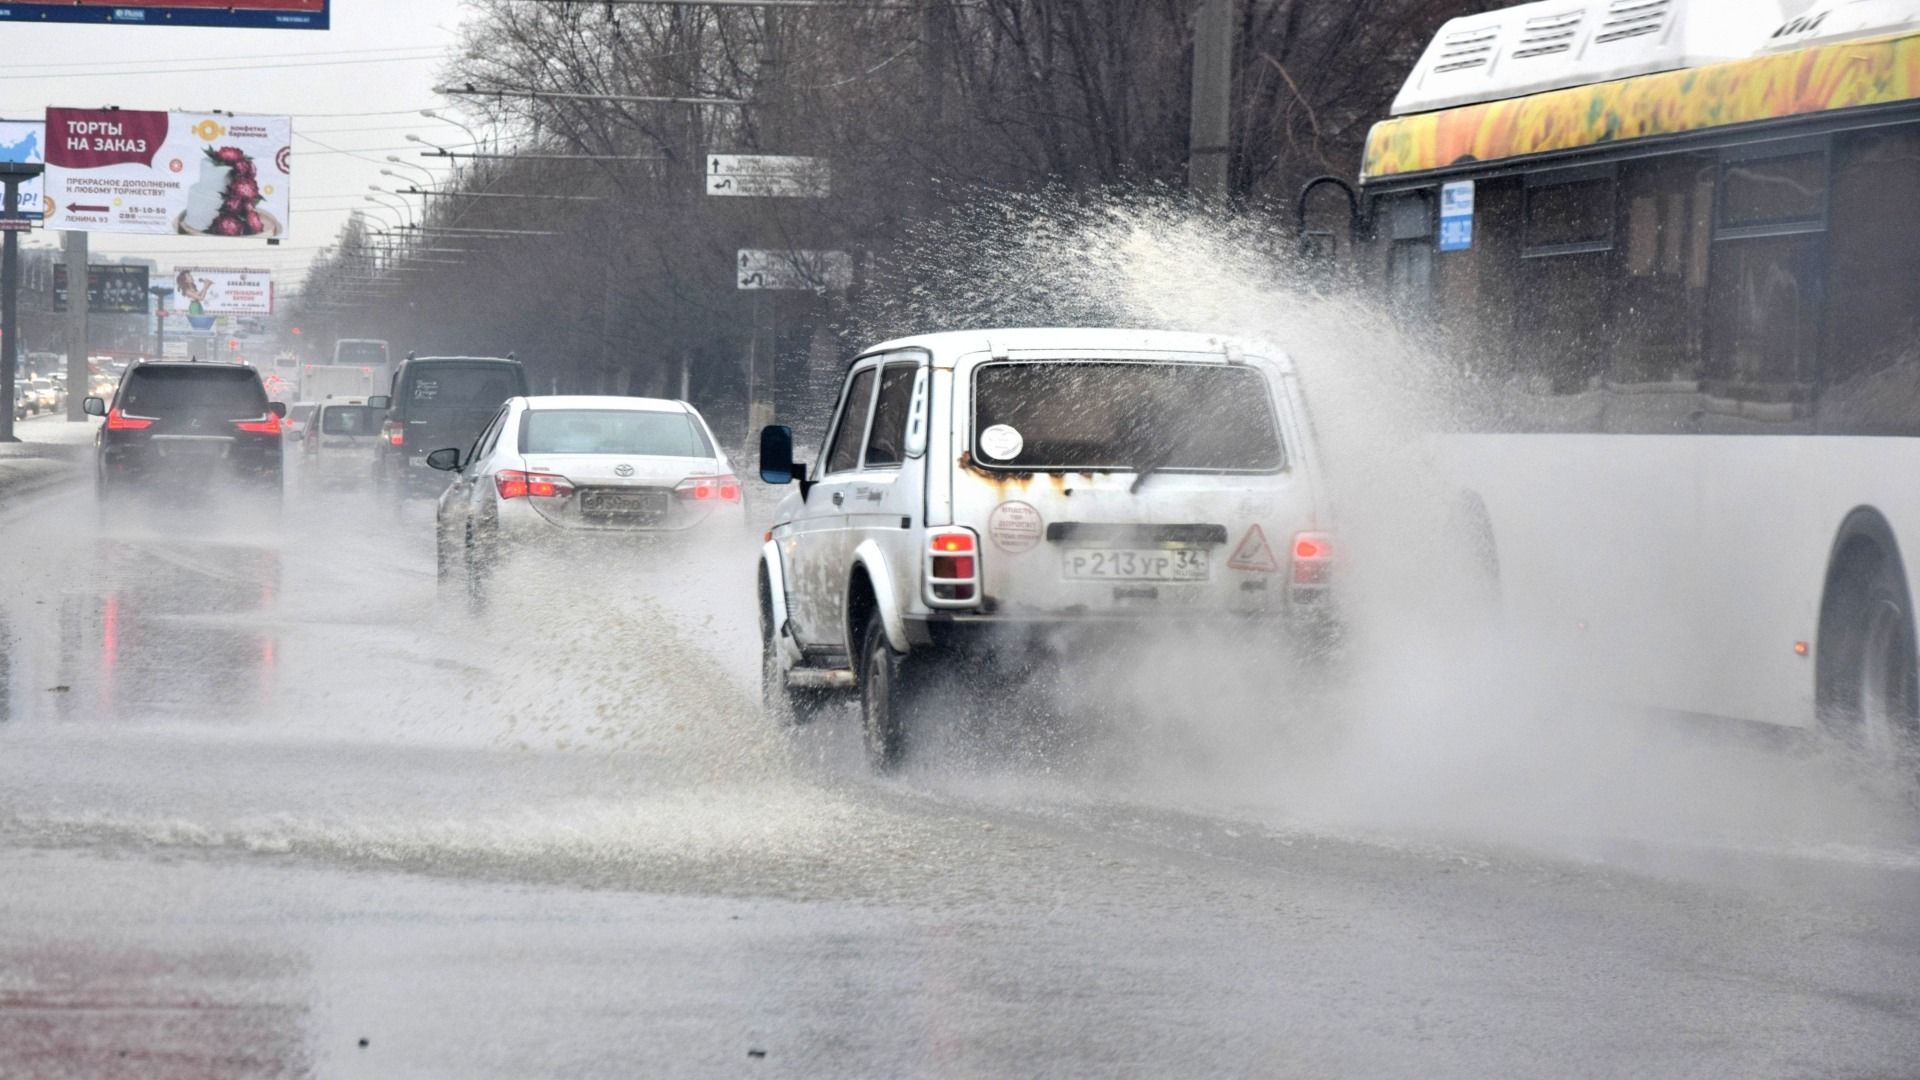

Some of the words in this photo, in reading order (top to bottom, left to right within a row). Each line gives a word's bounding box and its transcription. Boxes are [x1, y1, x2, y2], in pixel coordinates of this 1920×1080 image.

[67, 121, 123, 136] ТОРТЫ
[66, 137, 89, 151] НА
[94, 138, 147, 153] ЗАКАЗ
[66, 177, 120, 188] ПРЕКРАСНОЕ
[122, 179, 181, 189] ДОПОЛНЕНИЕ
[74, 186, 111, 194] ЛЮБОМУ
[113, 187, 166, 196] ТОРЖЕСТВУ!
[65, 215, 97, 223] ЛЕНИНА
[1176, 550, 1199, 571] 34
